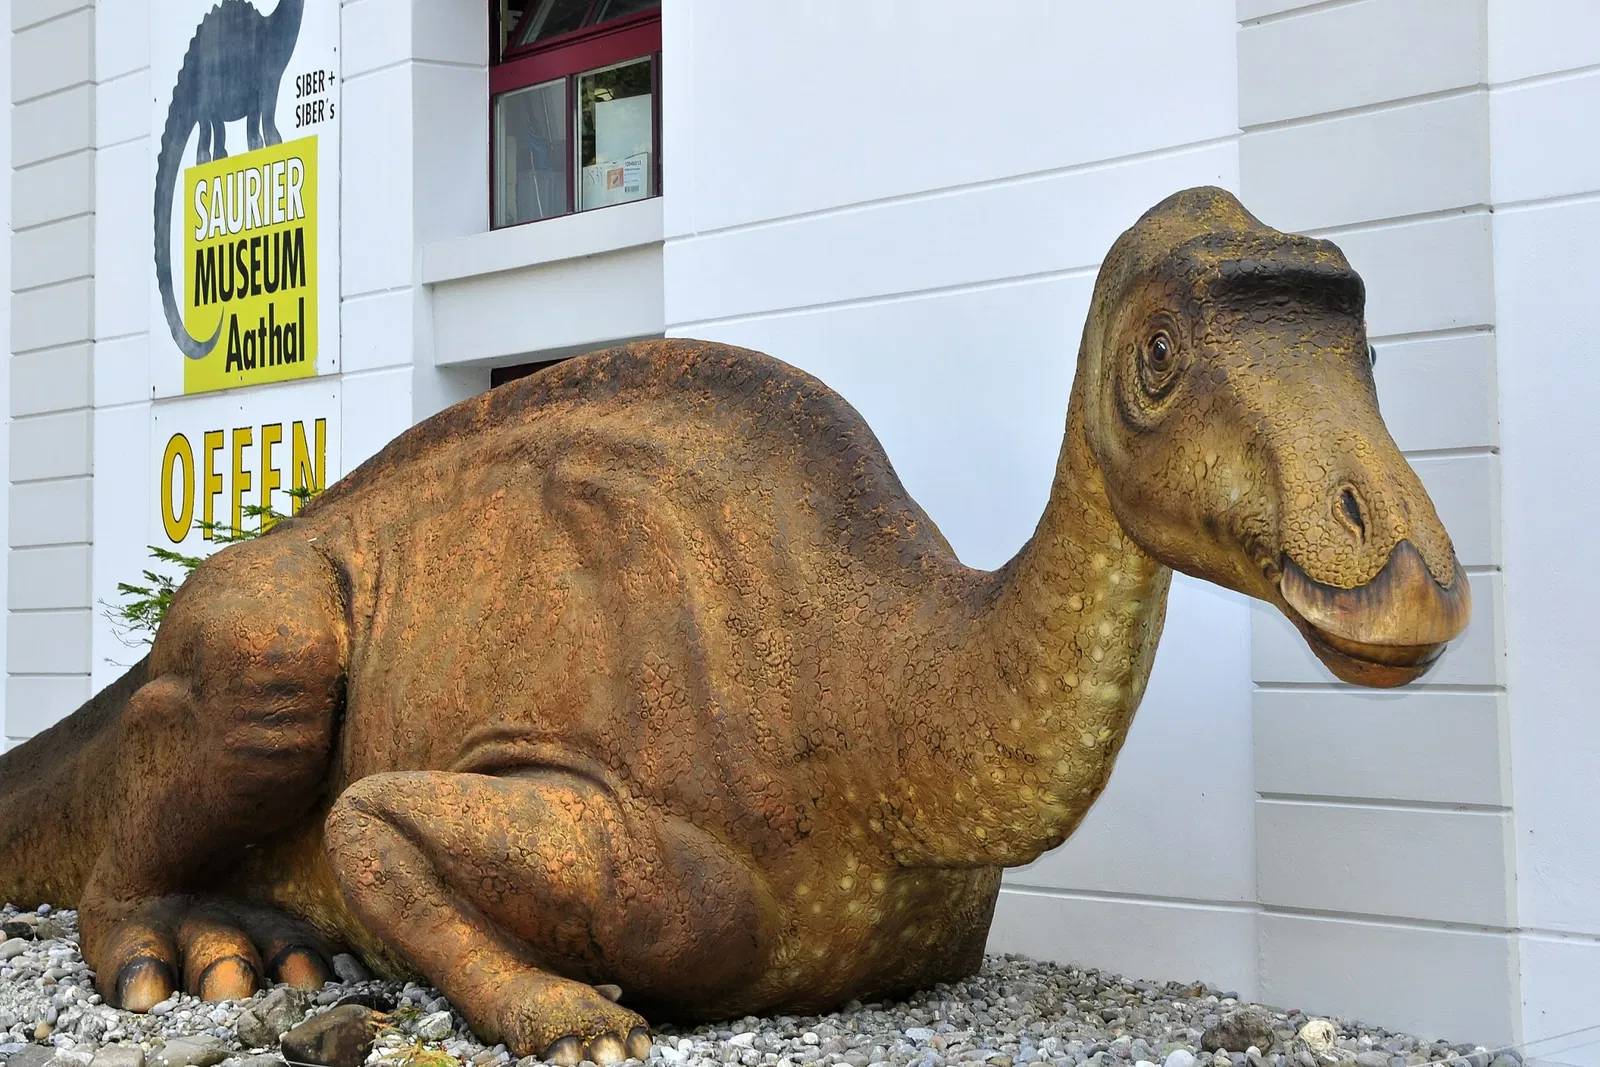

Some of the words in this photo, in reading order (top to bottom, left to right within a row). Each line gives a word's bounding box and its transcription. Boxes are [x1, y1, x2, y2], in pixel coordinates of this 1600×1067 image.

[295, 69, 325, 99] SIBER
[328, 71, 336, 86] +
[194, 157, 305, 243] SAURIER
[194, 227, 306, 308] MUSEUM
[225, 297, 306, 374] Aathal
[160, 417, 327, 544] OFFEN
